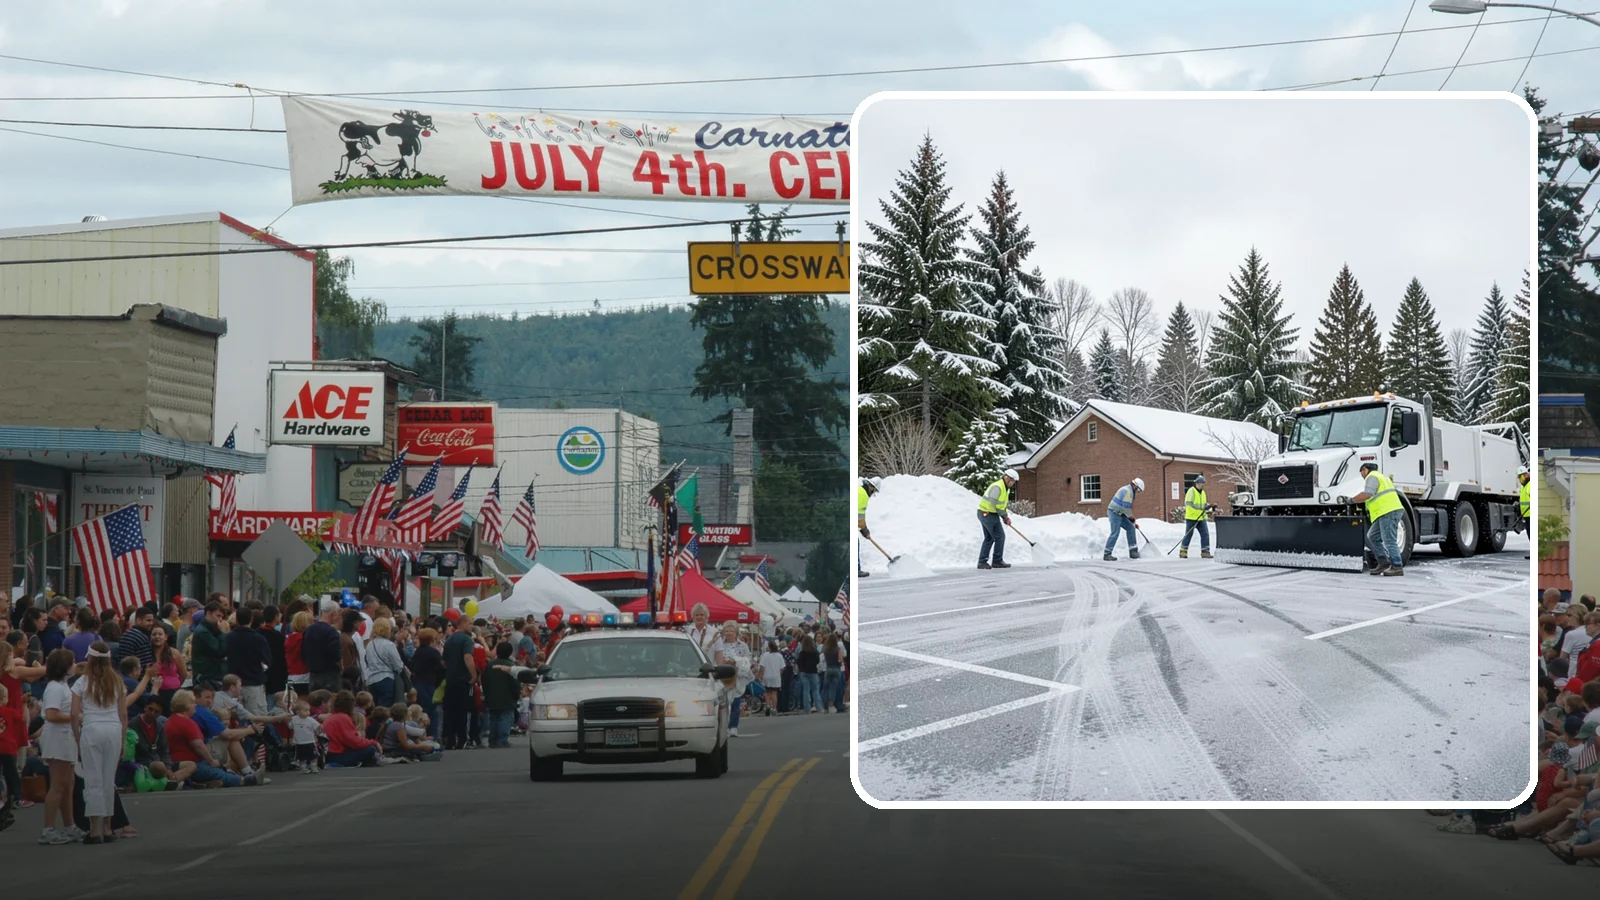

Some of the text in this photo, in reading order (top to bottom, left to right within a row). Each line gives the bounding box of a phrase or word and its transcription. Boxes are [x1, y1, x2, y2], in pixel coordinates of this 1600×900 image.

[481, 141, 605, 193] JULY
[632, 150, 746, 198] 4th.
[697, 254, 850, 280] CROSSWA
[283, 380, 374, 420] ACE
[405, 409, 485, 422] CEDAR LOG
[283, 421, 371, 437] Hardware
[416, 428, 477, 447] Coca-Cola
[96, 485, 124, 495] Vincent
[126, 486, 136, 495] de
[137, 486, 155, 496] Paul
[81, 503, 154, 522] THT
[688, 526, 742, 535] CRNATION
[699, 535, 730, 544] GLASS
